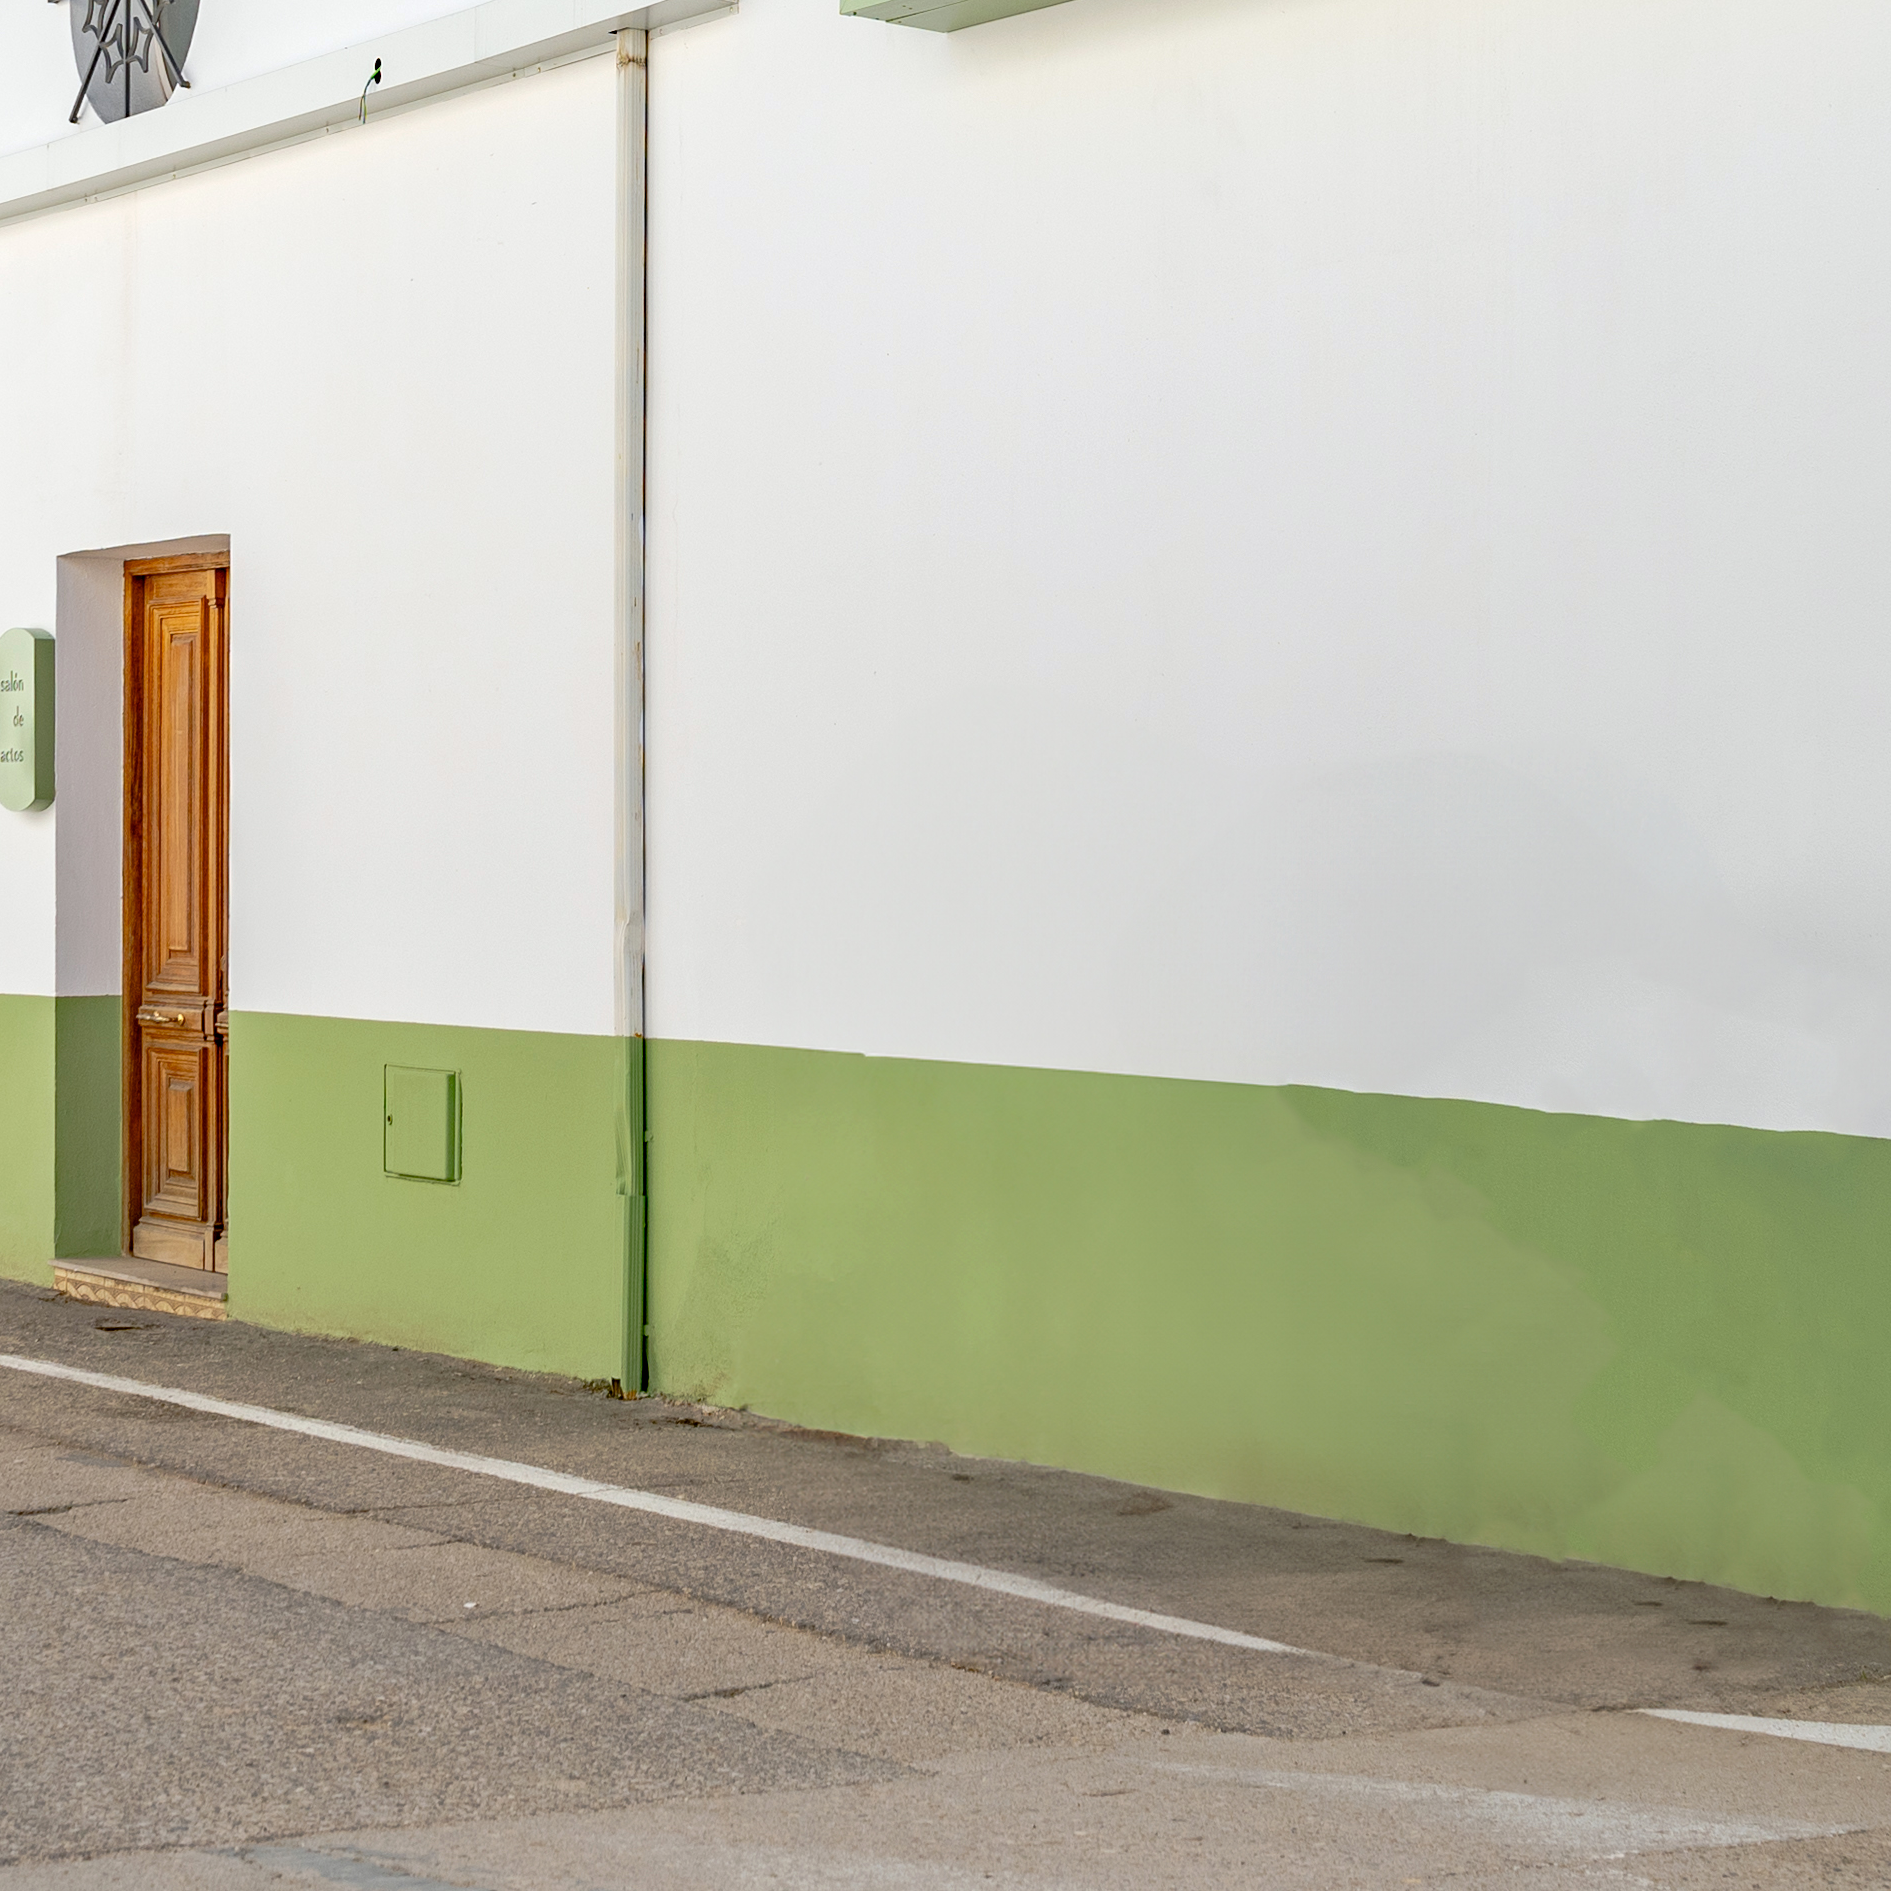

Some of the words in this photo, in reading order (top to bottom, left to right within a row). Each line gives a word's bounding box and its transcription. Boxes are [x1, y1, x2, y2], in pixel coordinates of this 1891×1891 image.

[0, 670, 24, 692] salón
[13, 706, 24, 727] de
[0, 747, 24, 763] actos
